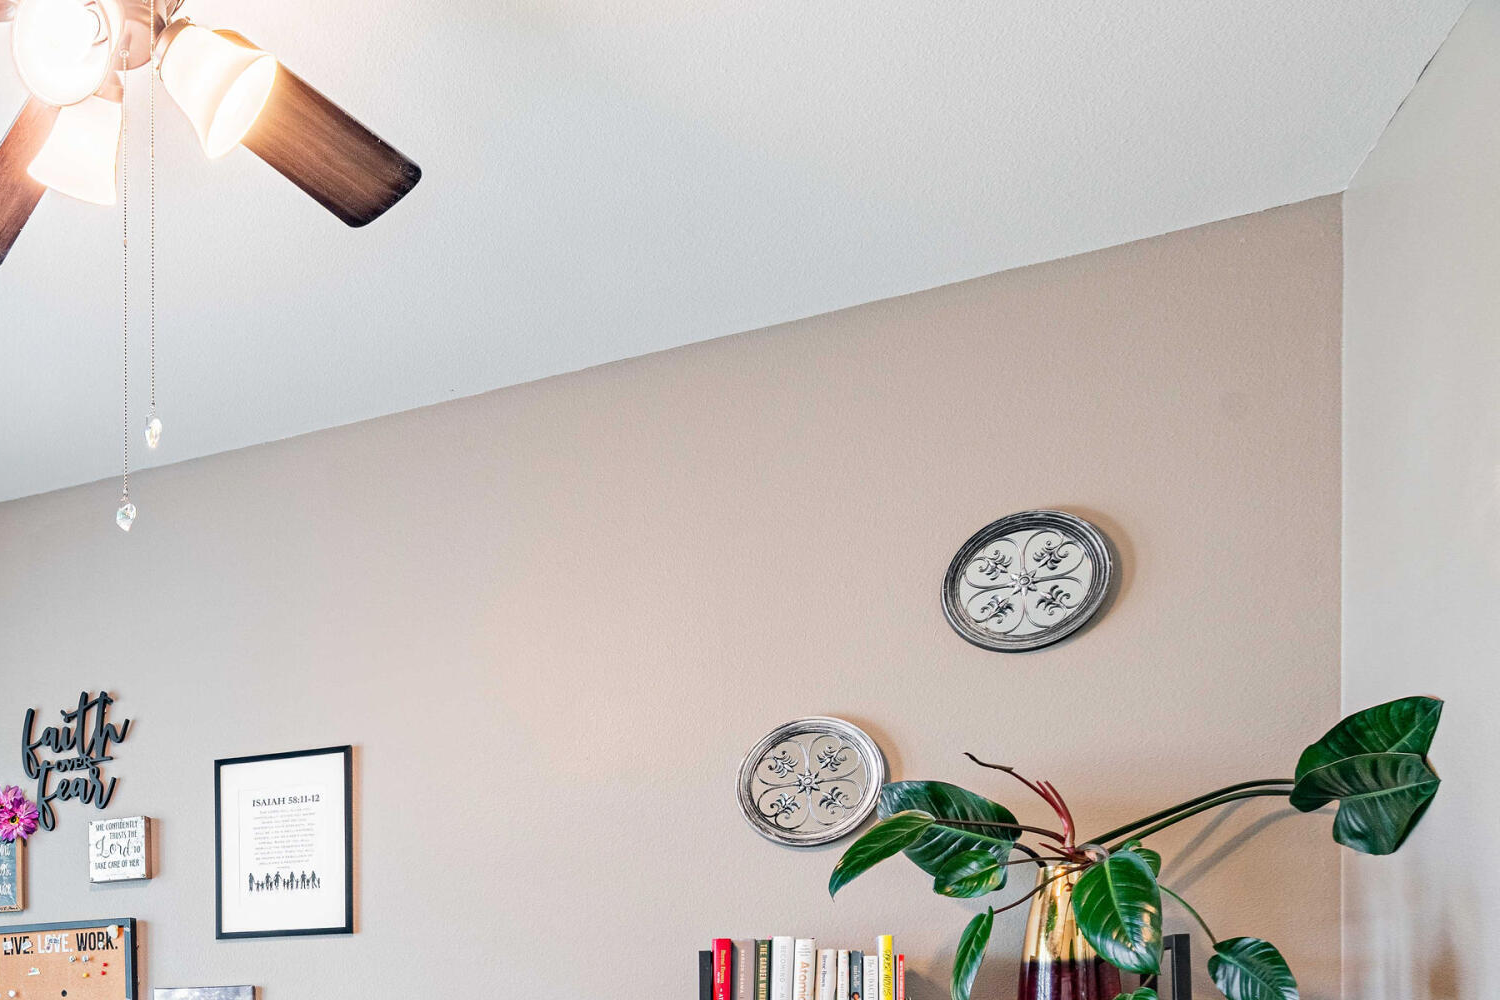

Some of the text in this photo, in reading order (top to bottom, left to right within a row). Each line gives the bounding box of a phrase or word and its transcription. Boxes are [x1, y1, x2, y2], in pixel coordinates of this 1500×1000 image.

[22, 691, 130, 779] faith
[55, 757, 93, 772] OVER
[37, 760, 116, 831] fear
[252, 794, 320, 807] ISAIAH 58:11-12
[106, 820, 138, 830] CONFIDENTLY
[96, 835, 131, 858] Lord
[108, 860, 120, 868] CARE
[759, 957, 767, 981] GARDEN
